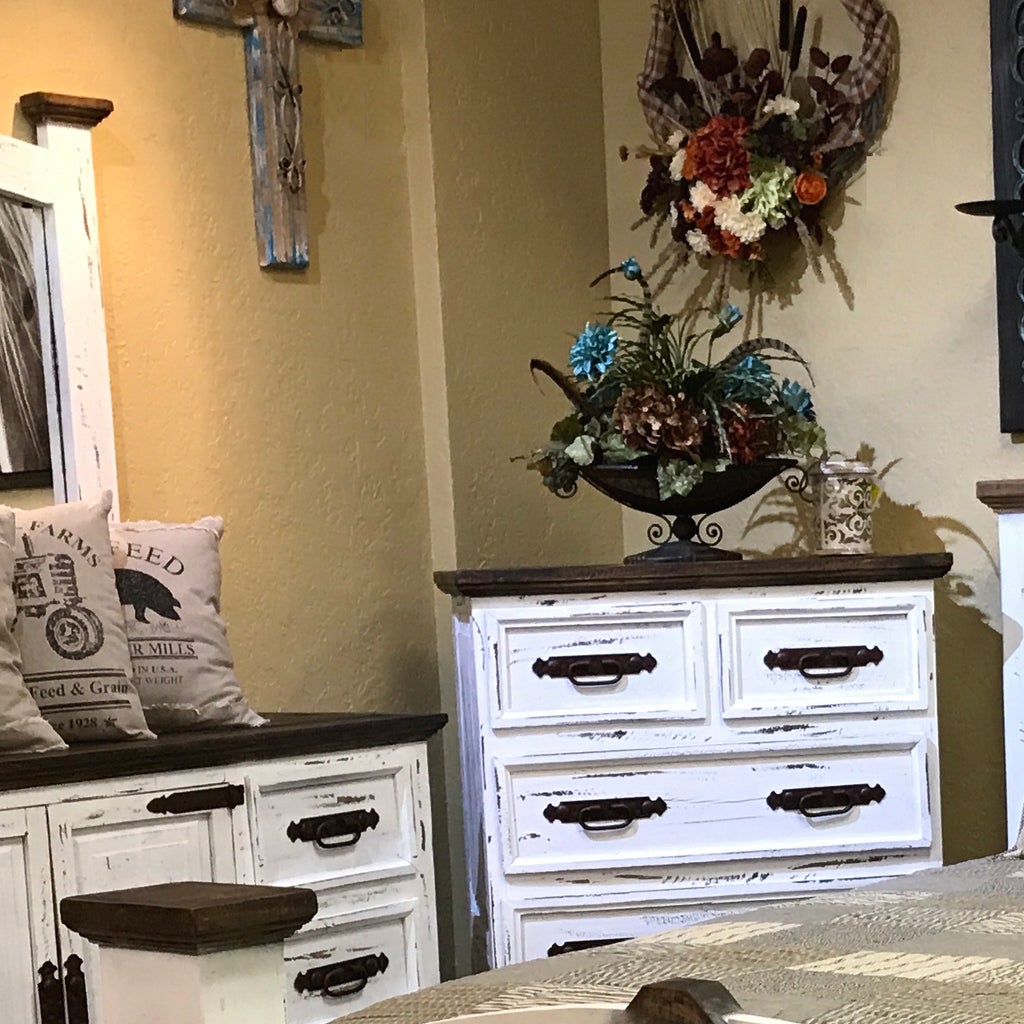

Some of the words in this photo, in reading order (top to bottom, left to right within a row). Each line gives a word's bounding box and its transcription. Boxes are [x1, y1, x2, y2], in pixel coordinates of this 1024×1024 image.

[30, 520, 100, 568] FARMS
[148, 642, 195, 656] MILLS
[144, 675, 184, 685] WEIGHT
[29, 683, 66, 699] Feed
[70, 681, 85, 697] &
[89, 680, 128, 695] Grain
[69, 716, 98, 729] 1928
